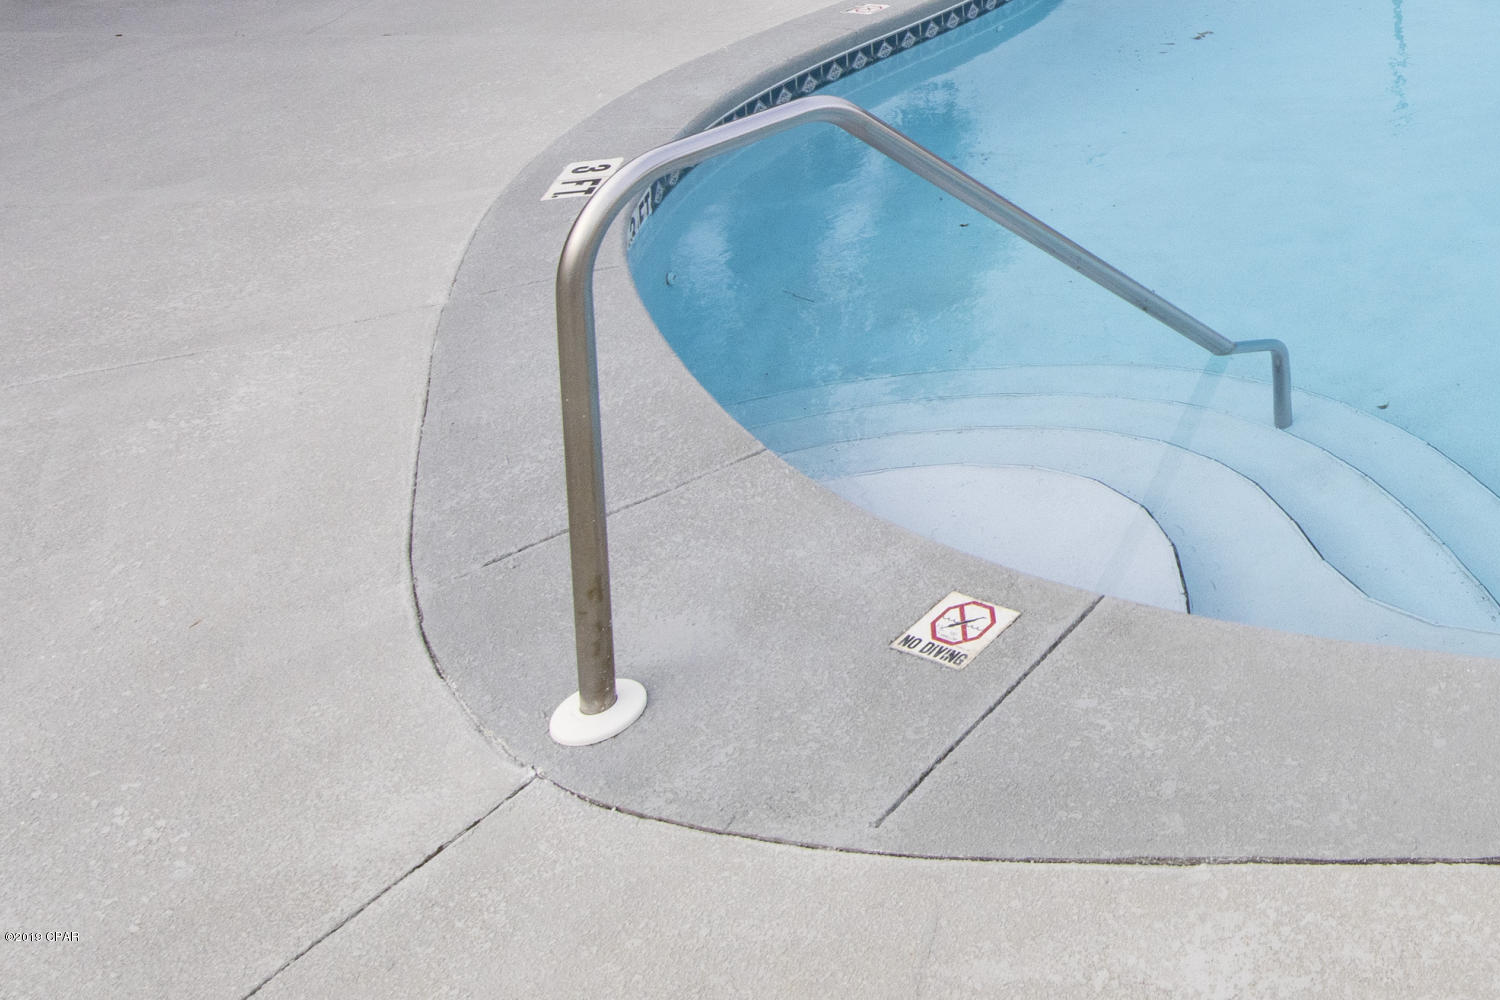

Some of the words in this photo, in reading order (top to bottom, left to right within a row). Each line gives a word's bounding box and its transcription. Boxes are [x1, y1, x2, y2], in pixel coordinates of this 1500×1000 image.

[571, 164, 611, 174] 3
[639, 191, 650, 225] FT
[898, 634, 923, 649] NO
[919, 641, 968, 666] DIVING
